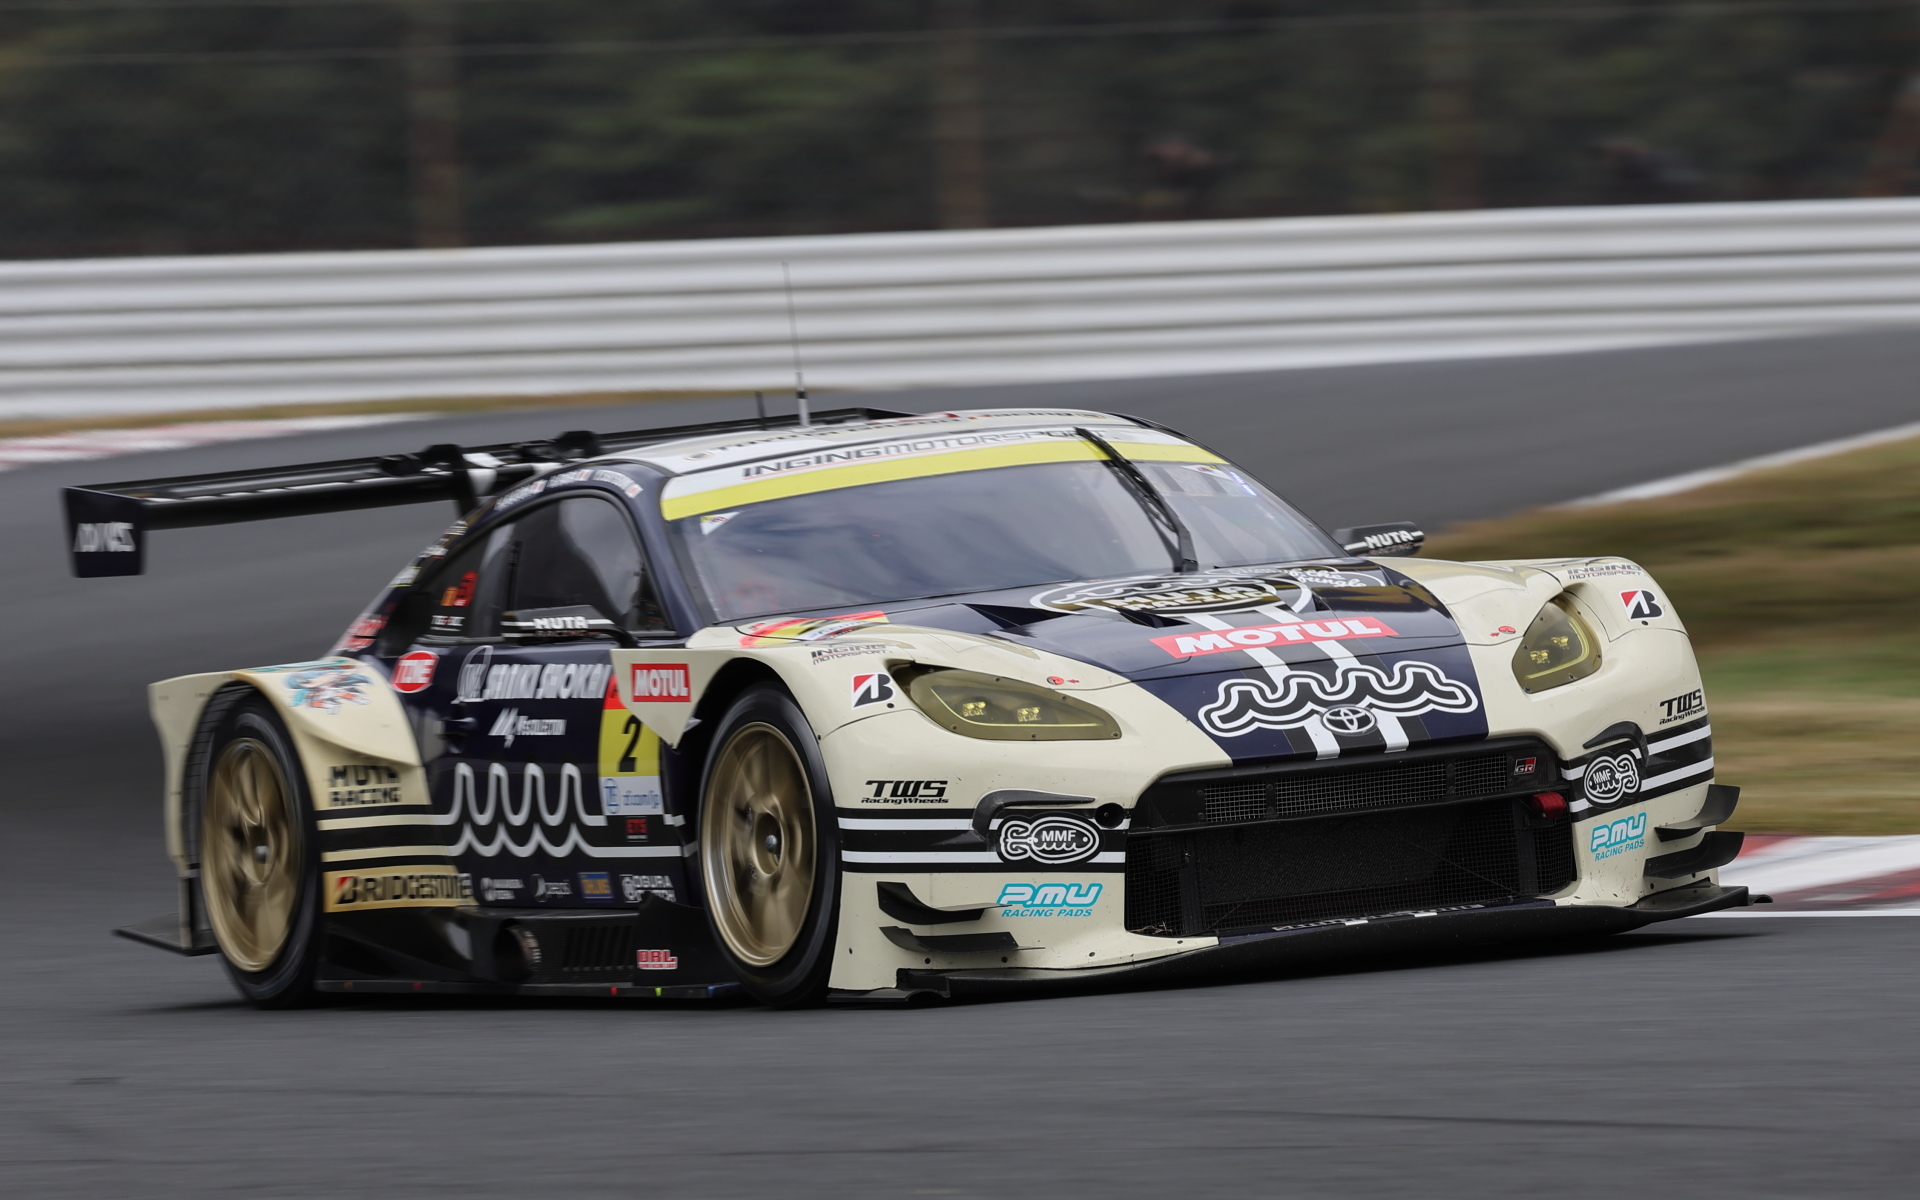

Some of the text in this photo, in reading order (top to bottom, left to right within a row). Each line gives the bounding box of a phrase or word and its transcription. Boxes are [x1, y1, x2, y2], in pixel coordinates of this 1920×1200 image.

[1567, 564, 1641, 574] INGING
[1569, 571, 1641, 580] MOTORSPORT
[1175, 619, 1381, 654] MOTUL
[811, 645, 886, 658] INGING
[812, 650, 887, 665] MOTORSPORT
[634, 669, 689, 697] MOTUL
[1659, 688, 1703, 717] TWS
[617, 713, 642, 773] 2
[1514, 763, 1535, 774] GR
[1592, 769, 1612, 784] MMF
[865, 780, 948, 797] TWS
[1041, 830, 1076, 842] MMF
[1595, 839, 1645, 861] RACING PADS
[1001, 908, 1092, 917] RACING PADS
